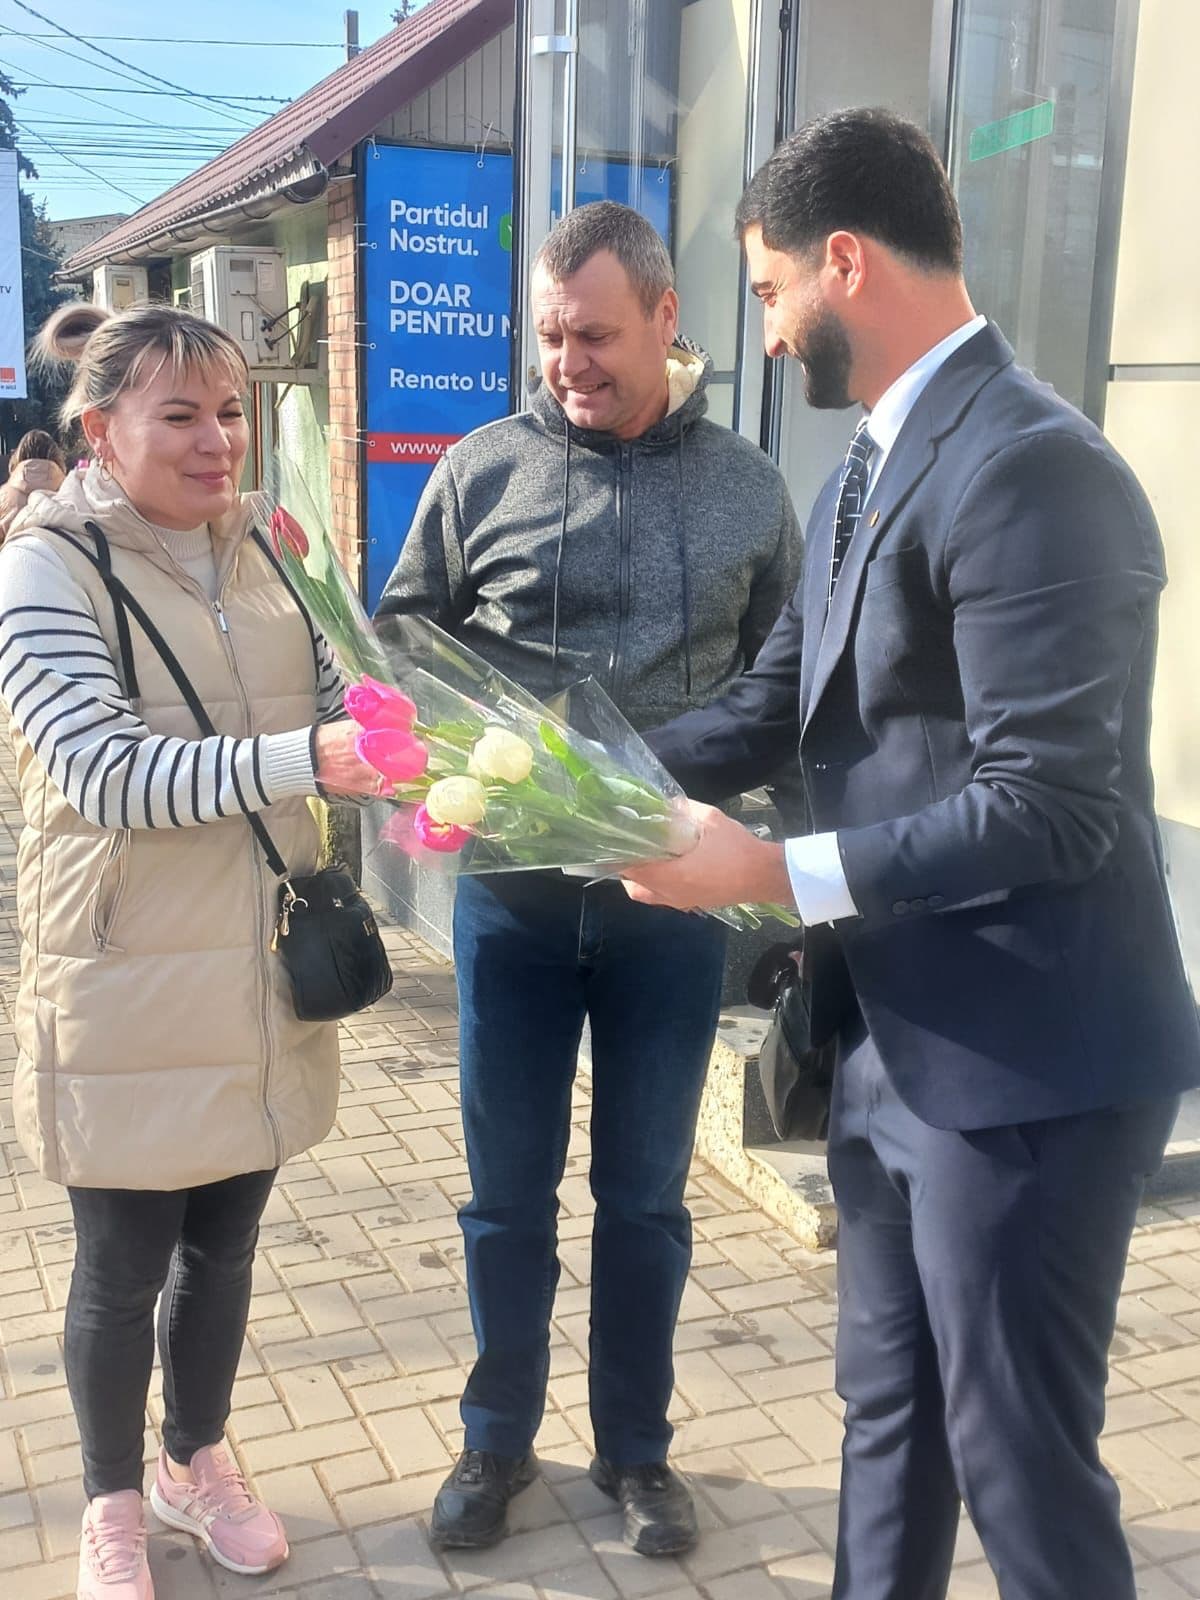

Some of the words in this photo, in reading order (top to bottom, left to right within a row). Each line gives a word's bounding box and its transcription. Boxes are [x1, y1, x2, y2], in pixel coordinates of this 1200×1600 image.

[390, 199, 488, 229] Partidul
[390, 227, 479, 256] Nostru.
[390, 280, 471, 308] DOAR
[390, 309, 494, 337] PENTRU
[390, 367, 474, 391] Renato
[481, 371, 510, 392] Us
[390, 442, 450, 455] www.
